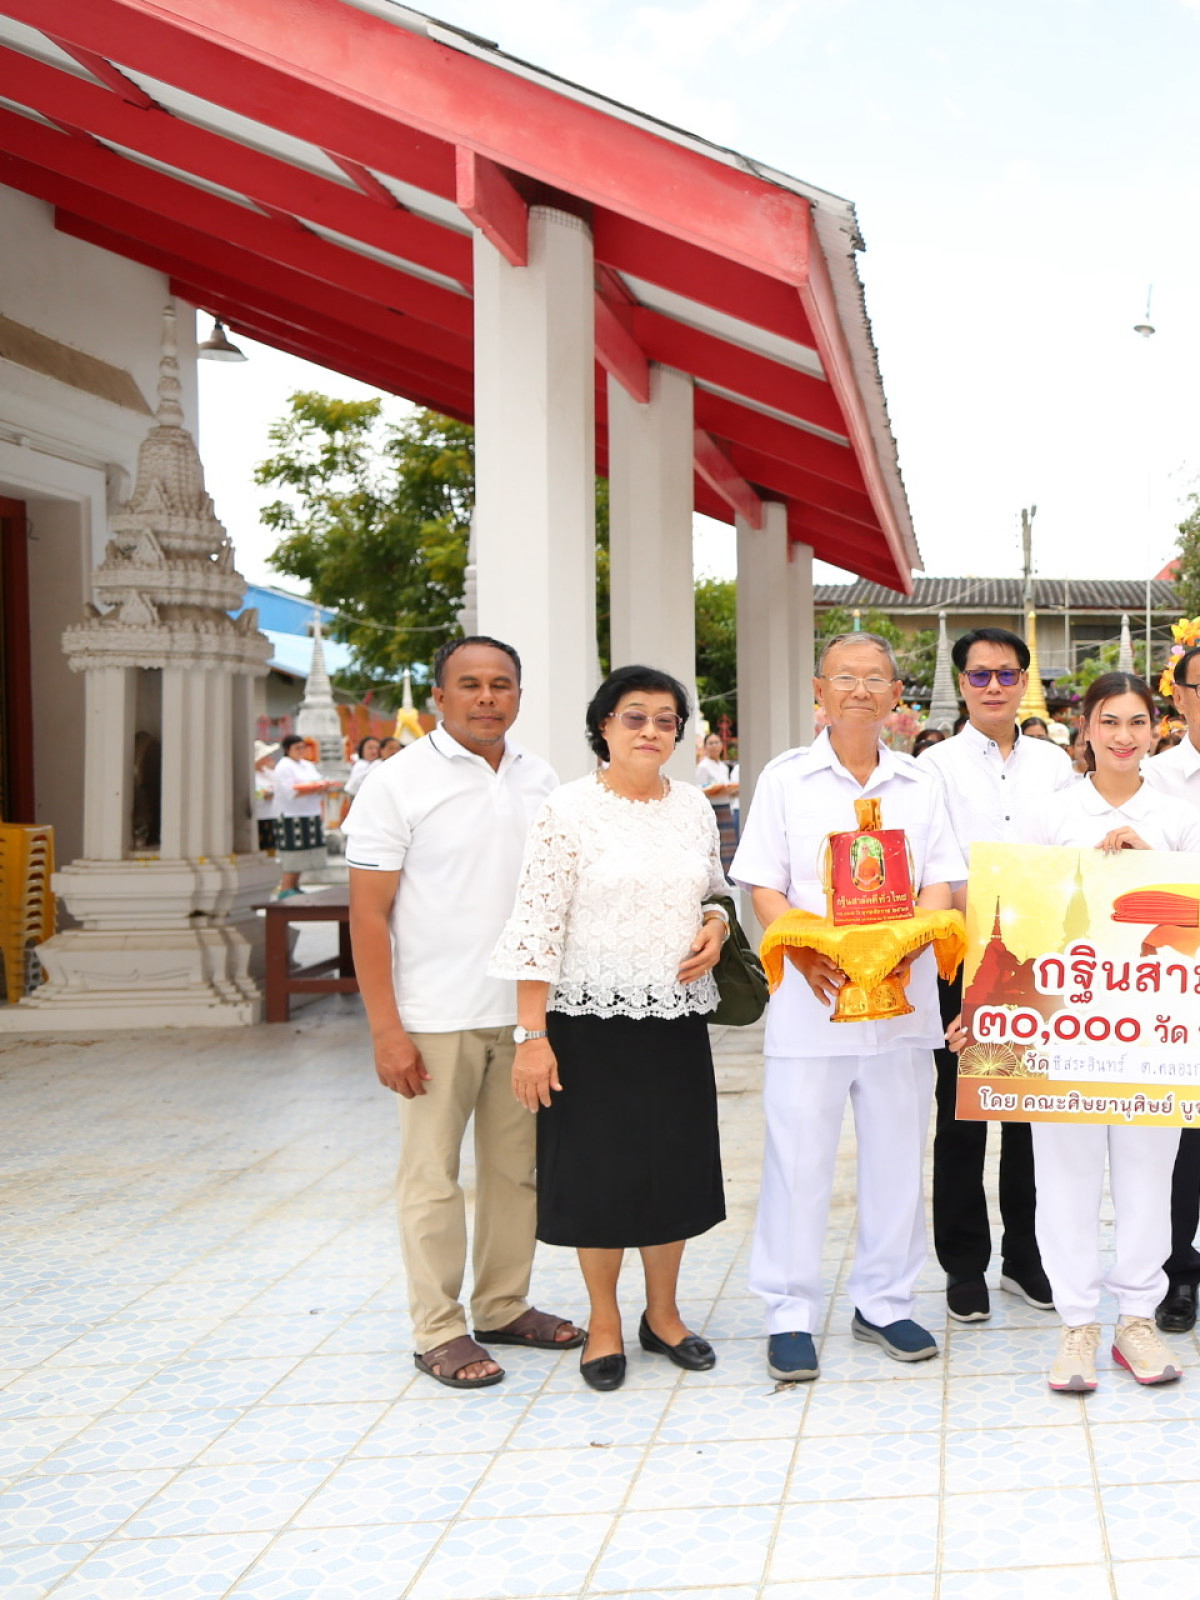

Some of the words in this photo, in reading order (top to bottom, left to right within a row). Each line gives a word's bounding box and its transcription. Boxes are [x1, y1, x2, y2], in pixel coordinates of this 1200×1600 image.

[979, 1011, 1141, 1045] ๓๐,๐๐๐
[1154, 1014, 1188, 1044] วัด
[1026, 1052, 1049, 1071] วัด
[980, 1088, 1016, 1108] โดย
[1024, 1092, 1173, 1119] คณะศิษยานุศิษย์
